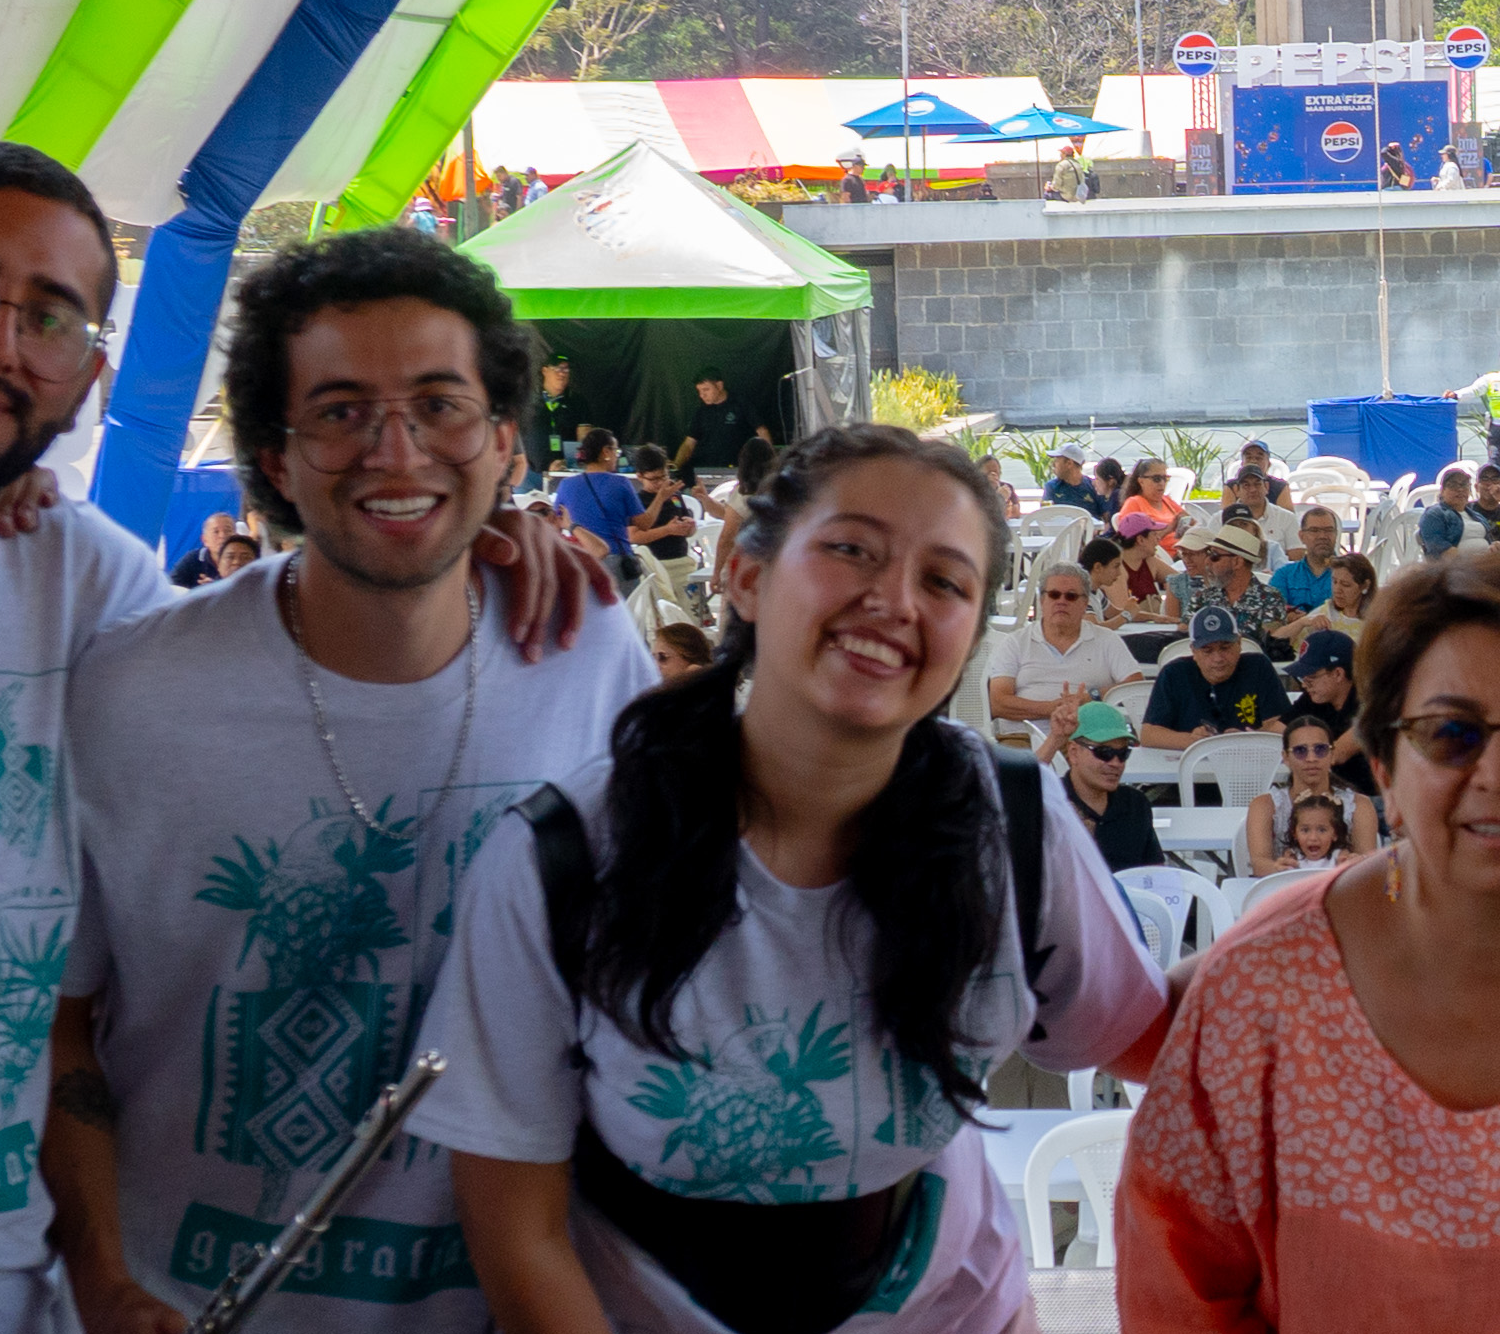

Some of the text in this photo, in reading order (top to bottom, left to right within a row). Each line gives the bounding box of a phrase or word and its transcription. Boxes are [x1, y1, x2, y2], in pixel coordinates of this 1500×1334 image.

[1447, 43, 1487, 54] PEPSI
[1177, 50, 1216, 61] PEPSI
[1237, 39, 1425, 88] PEPSI
[1305, 94, 1372, 105] EXTRA FIZZ
[1324, 137, 1360, 146] PEPSI
